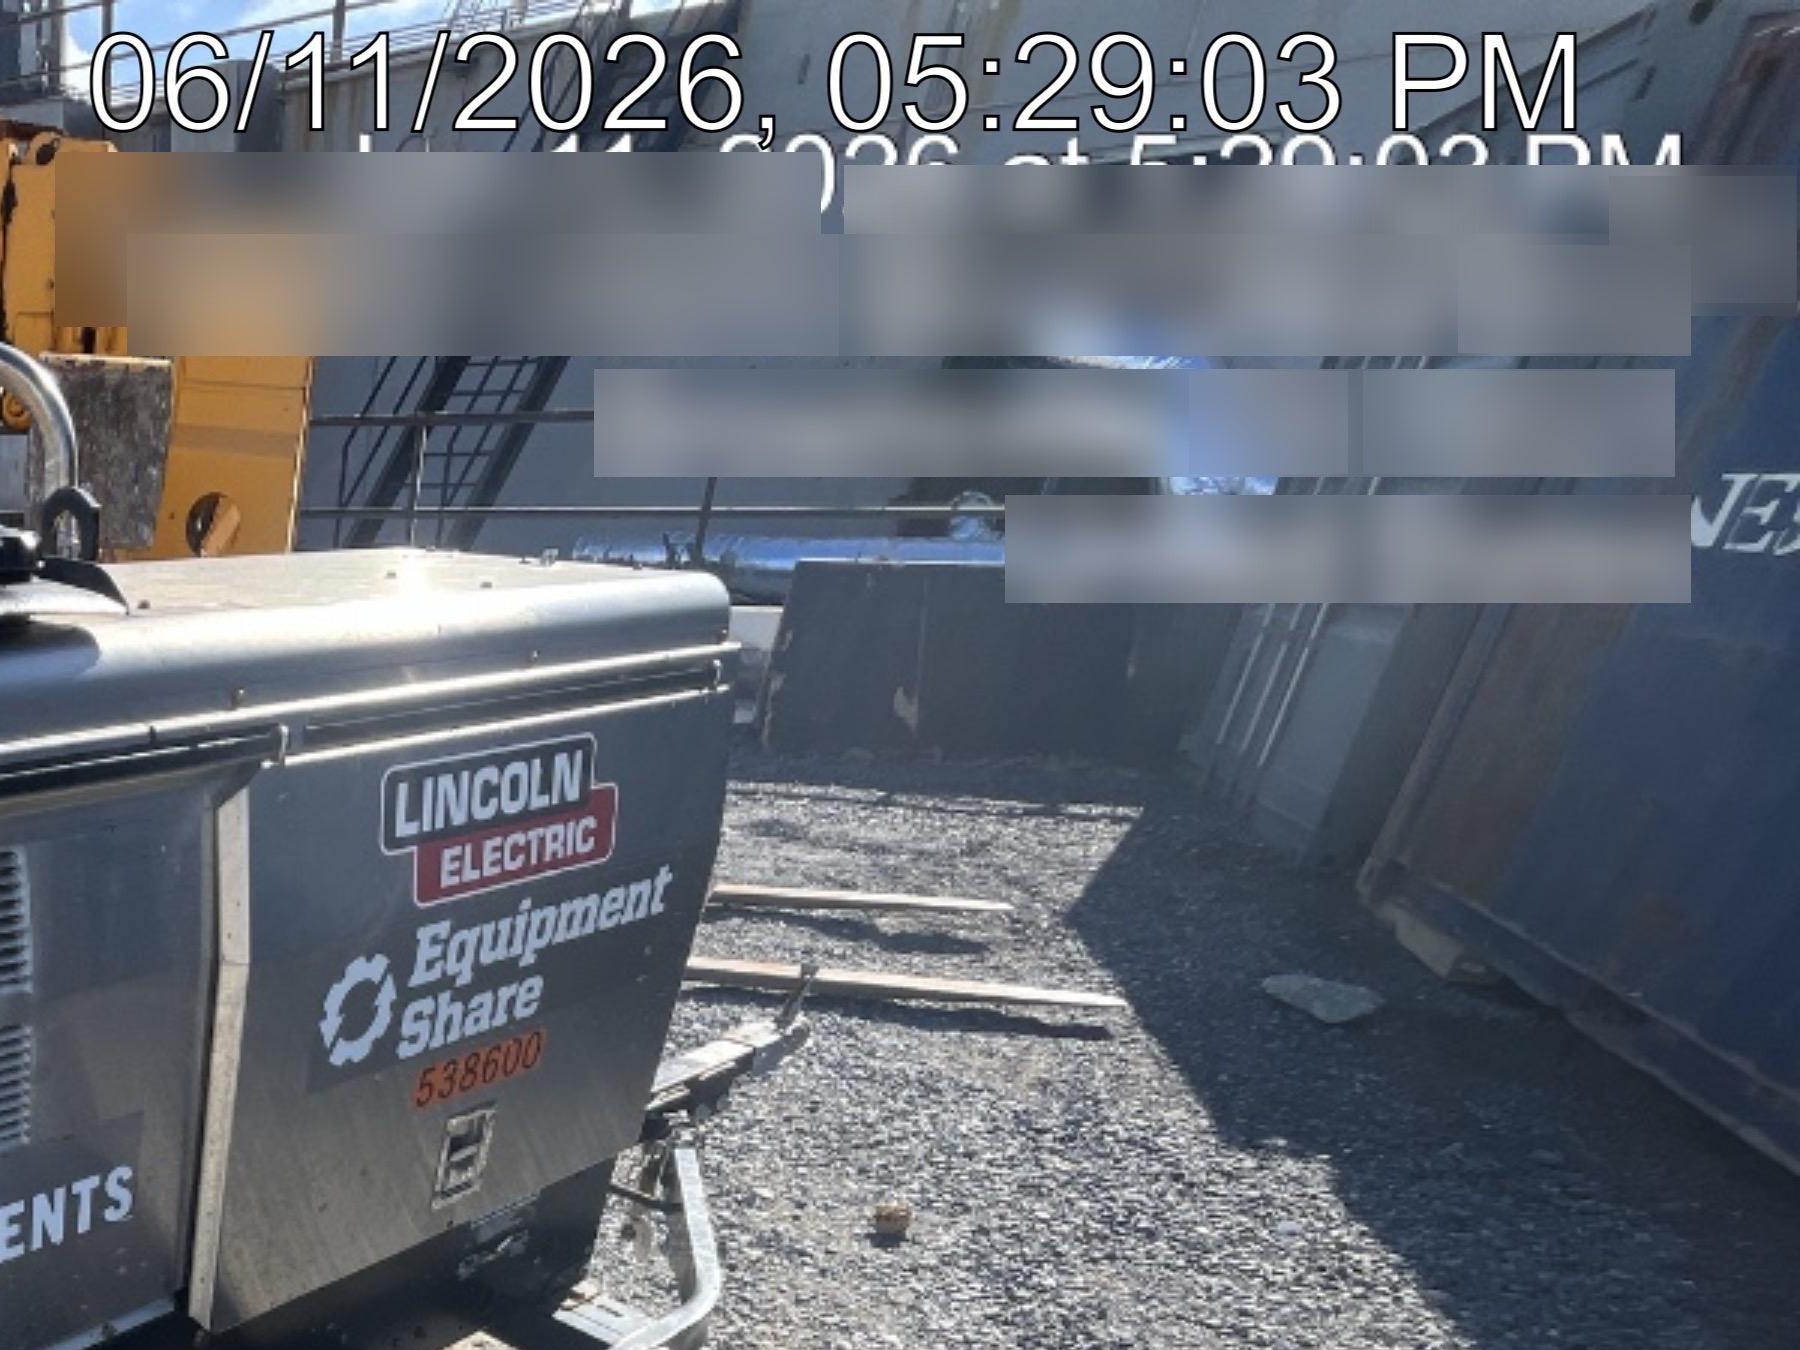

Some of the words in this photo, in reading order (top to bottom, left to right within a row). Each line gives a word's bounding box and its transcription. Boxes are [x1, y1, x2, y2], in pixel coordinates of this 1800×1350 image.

[394, 750, 583, 838] LINCOLN
[439, 815, 598, 888] ELECTRIC
[407, 863, 673, 989] Equipment
[395, 975, 545, 1060] Share
[415, 1030, 542, 1108] 538600
